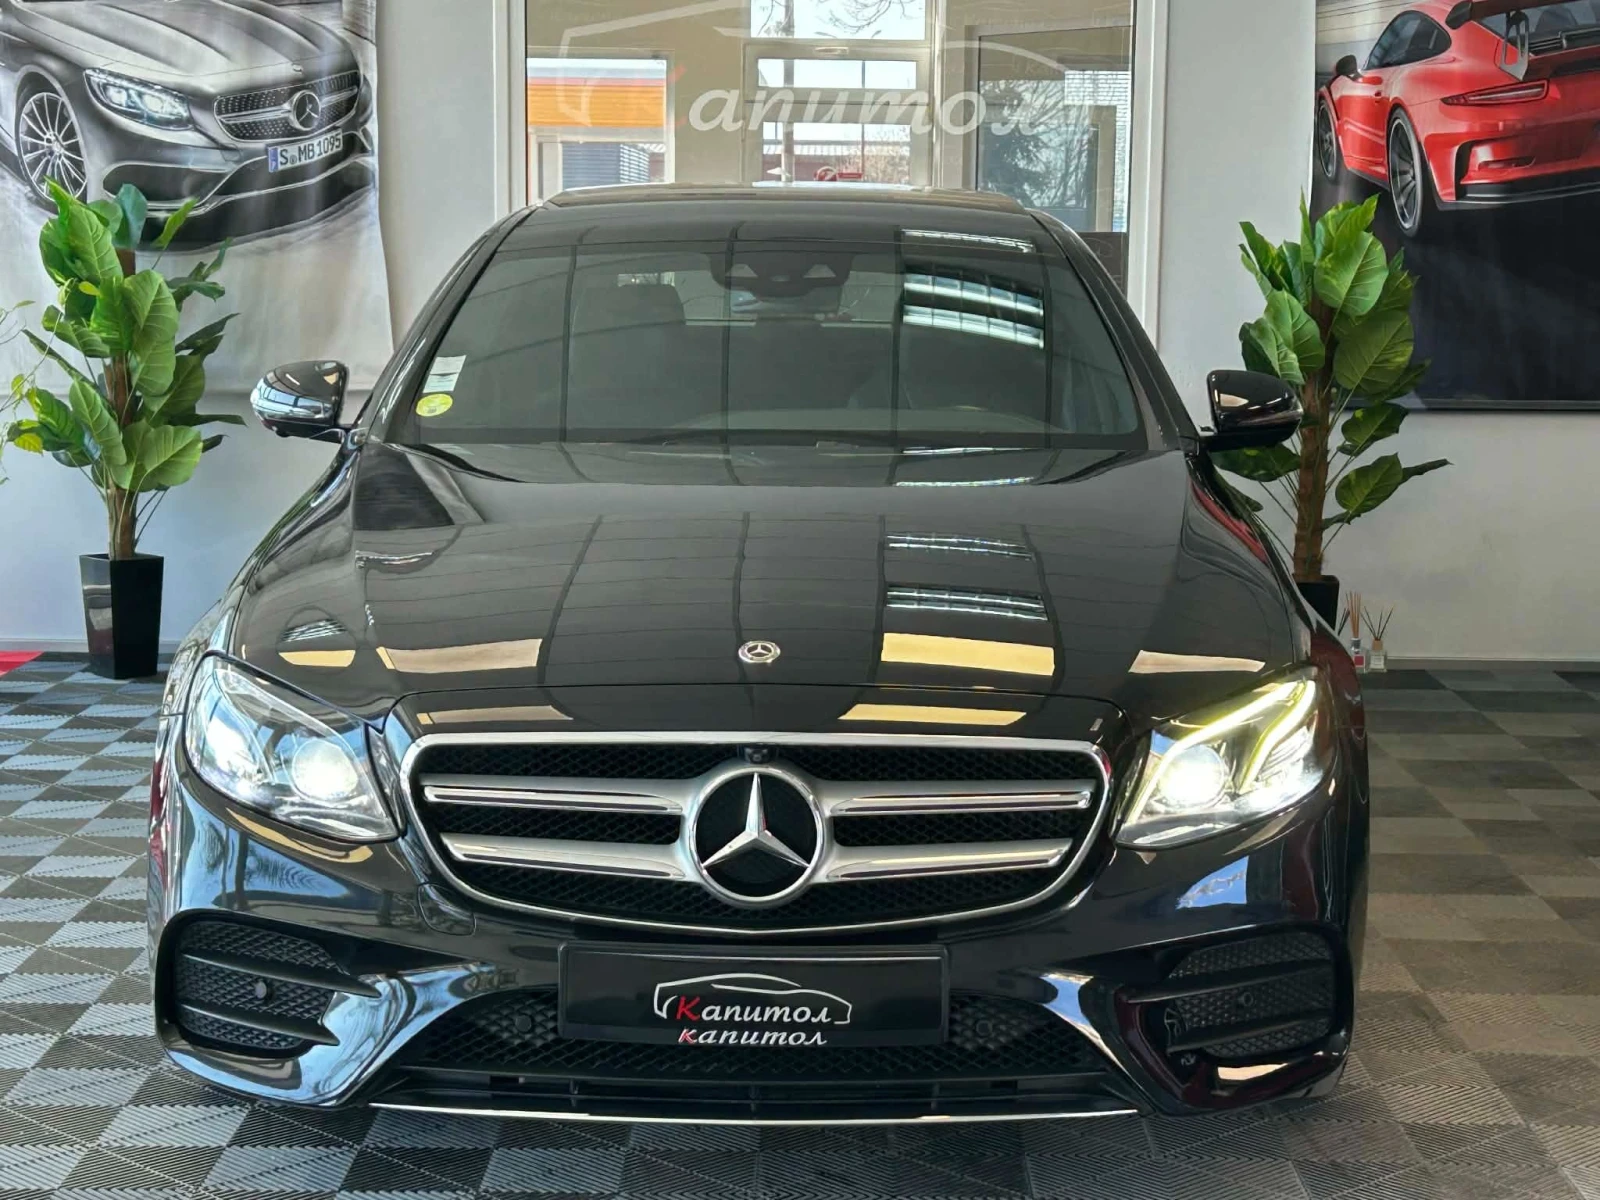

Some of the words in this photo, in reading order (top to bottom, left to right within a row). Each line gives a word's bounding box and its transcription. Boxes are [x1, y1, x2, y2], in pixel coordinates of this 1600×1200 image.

[664, 65, 1038, 134] апитол
[280, 149, 288, 165] S
[676, 996, 831, 1022] Капитол
